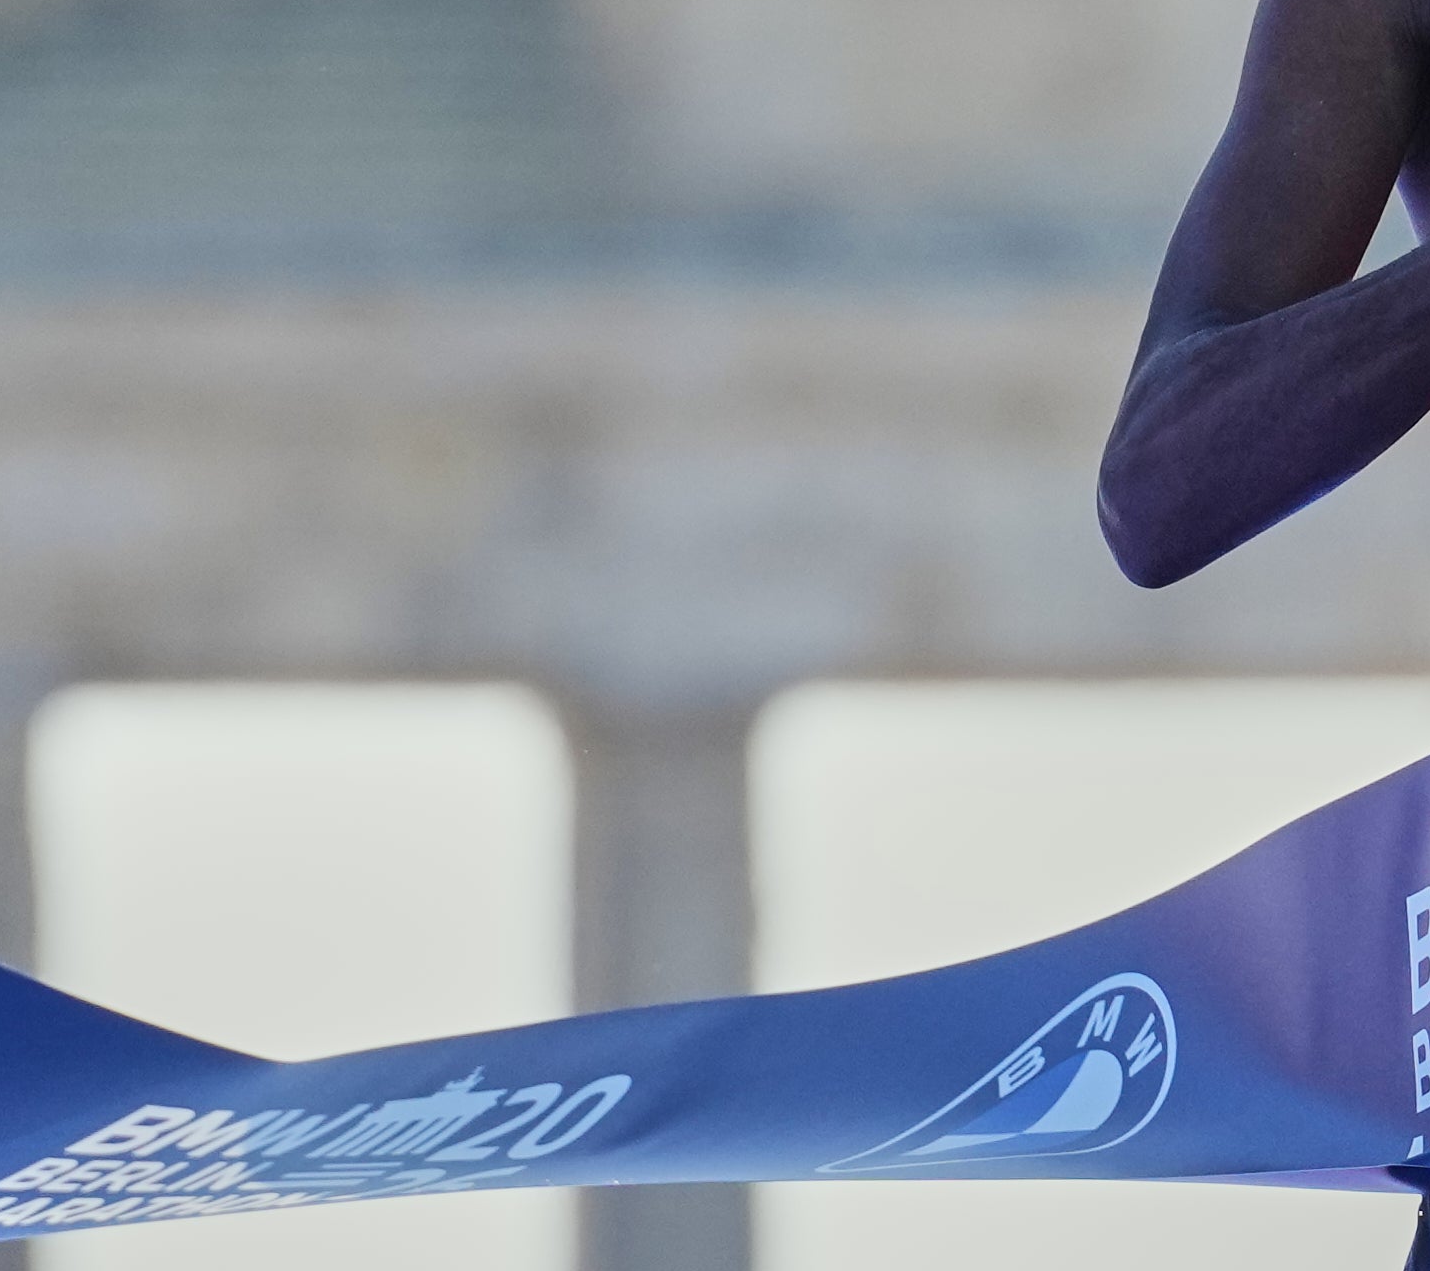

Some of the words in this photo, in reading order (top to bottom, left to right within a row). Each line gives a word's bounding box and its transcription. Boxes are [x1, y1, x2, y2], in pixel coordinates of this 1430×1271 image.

[998, 994, 1163, 1102] BMW
[64, 1104, 373, 1159] BMW
[425, 1074, 633, 1161] 20
